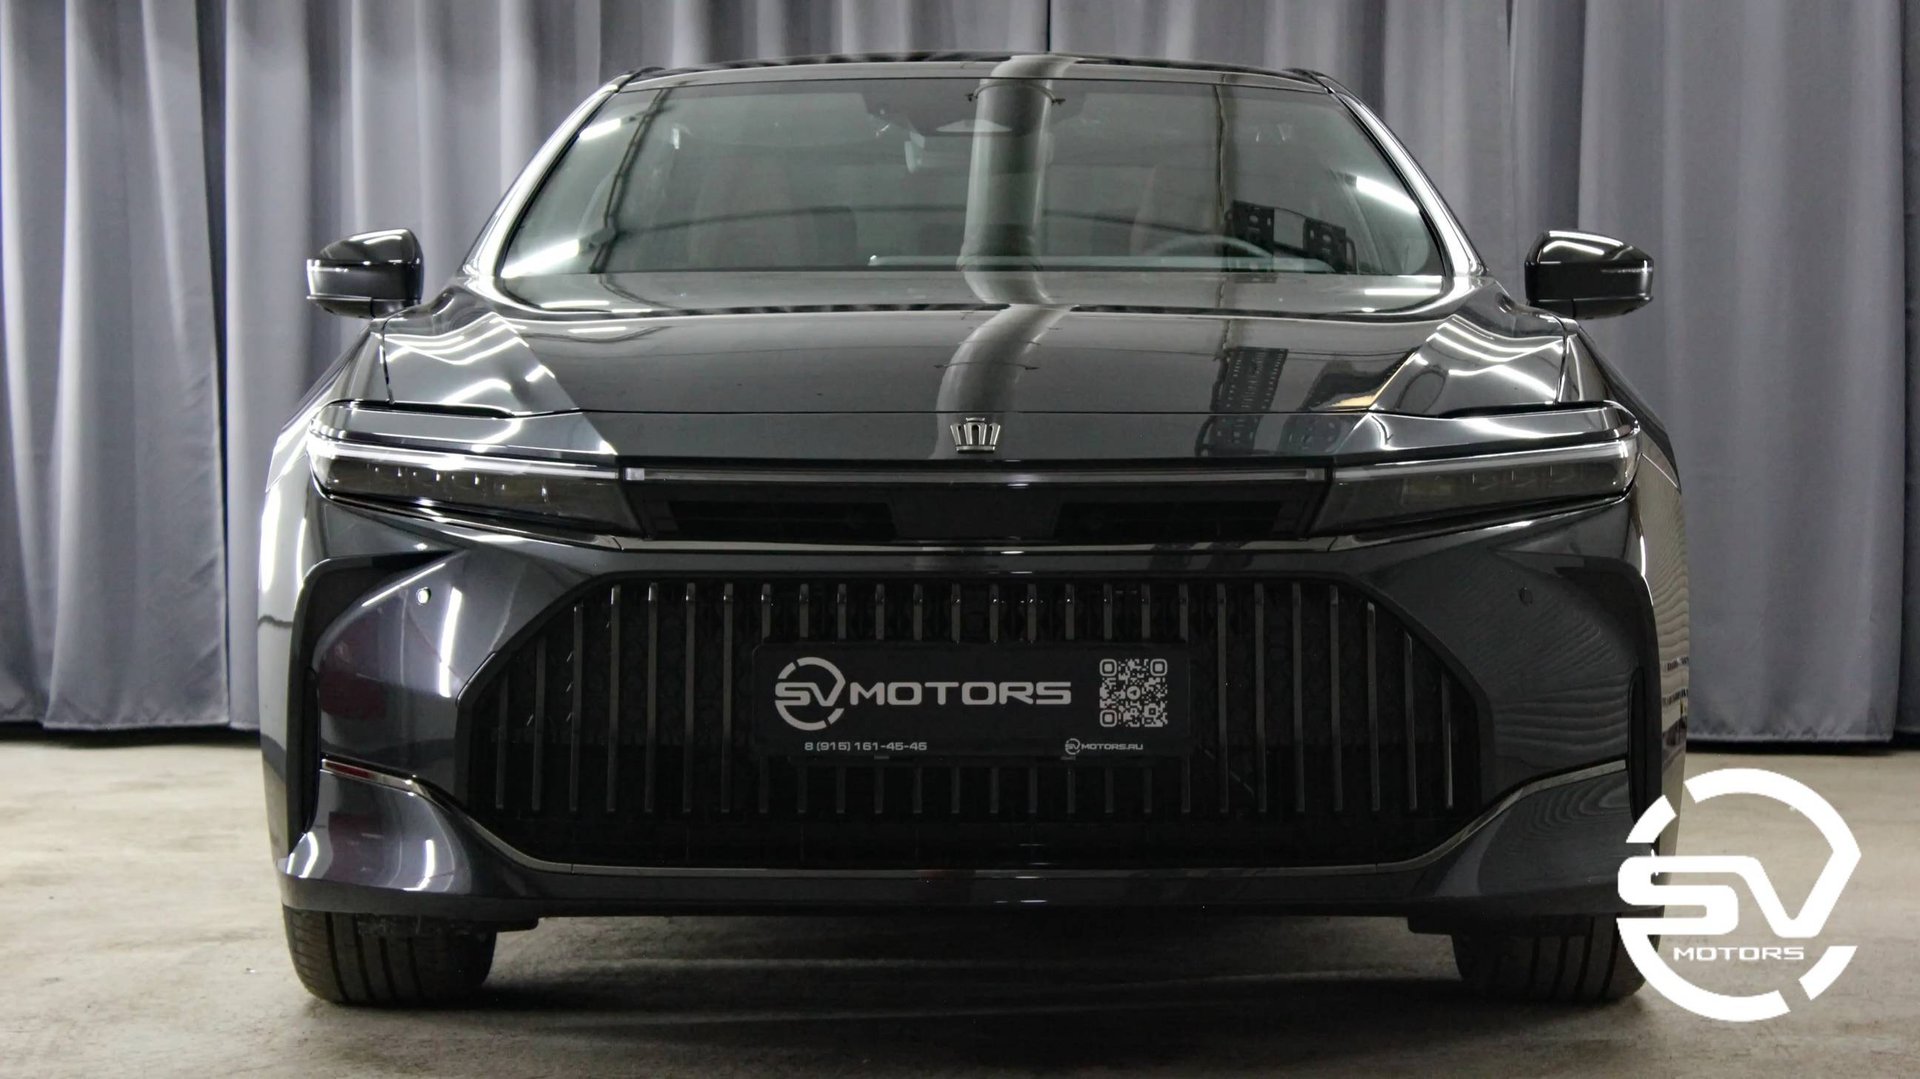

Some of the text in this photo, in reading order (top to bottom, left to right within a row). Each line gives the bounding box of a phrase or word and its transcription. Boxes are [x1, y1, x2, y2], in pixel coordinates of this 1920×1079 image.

[850, 682, 1071, 705] MOTORS
[804, 741, 928, 752] 8 (915) 161-45-45
